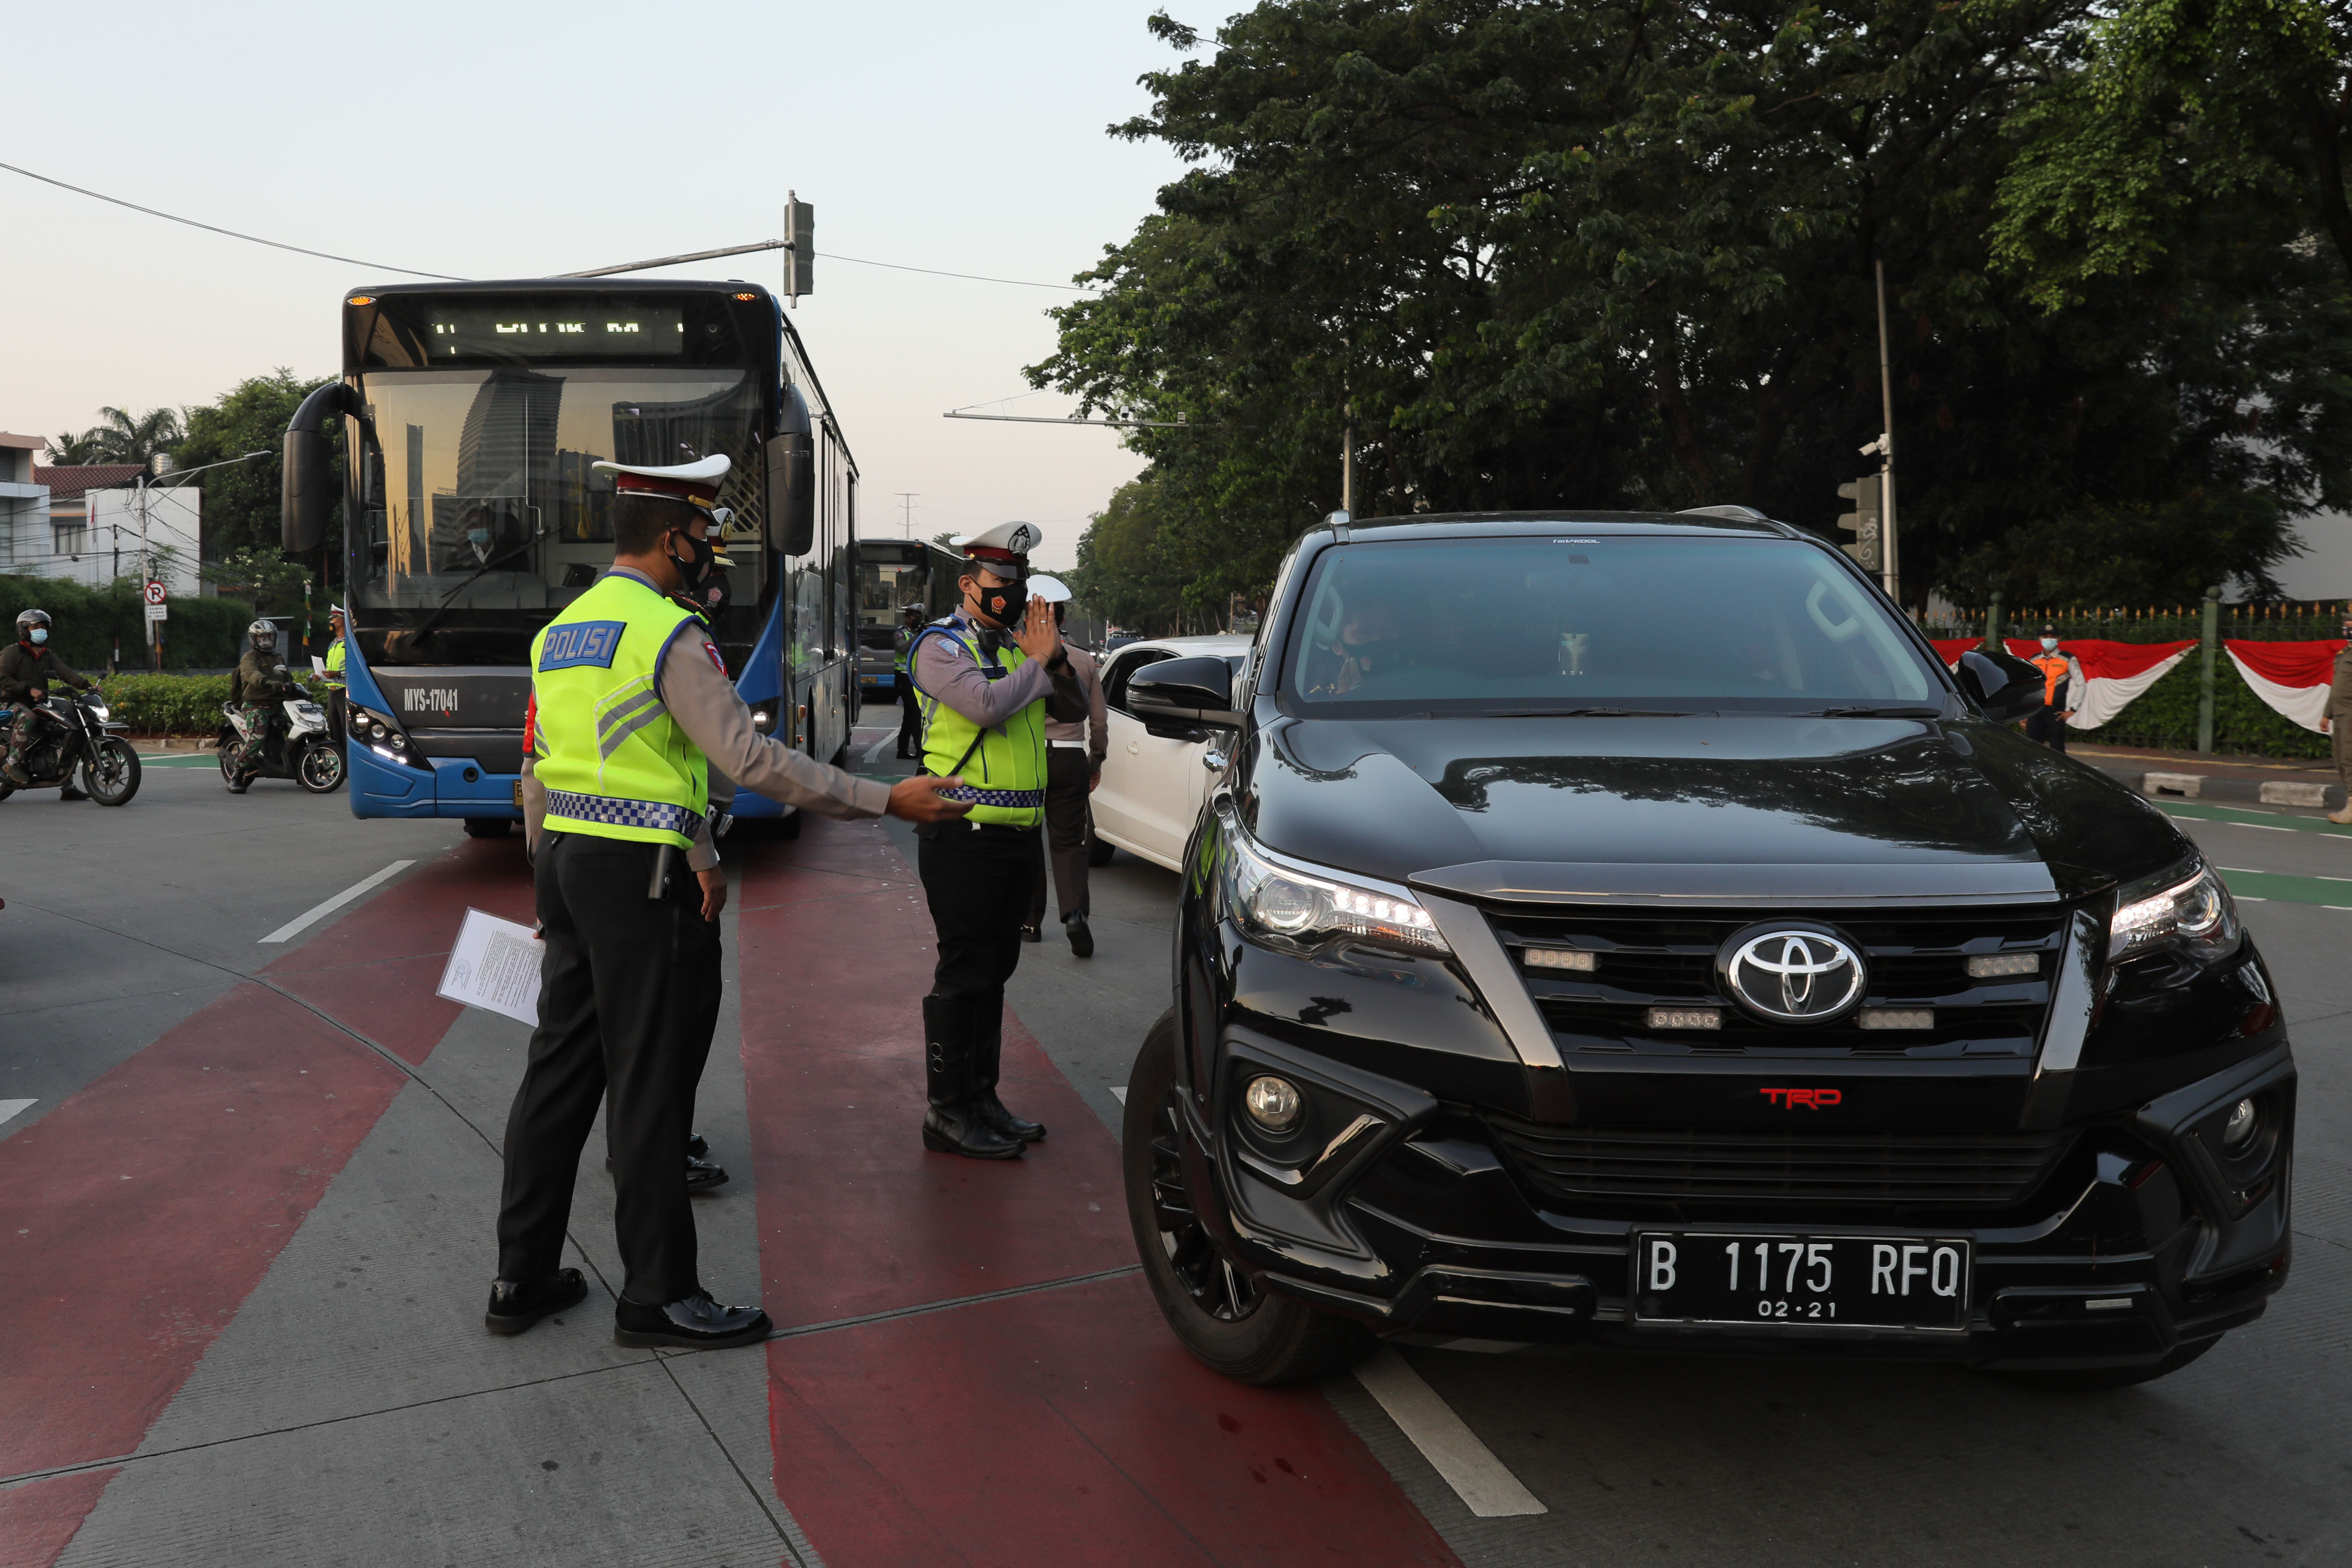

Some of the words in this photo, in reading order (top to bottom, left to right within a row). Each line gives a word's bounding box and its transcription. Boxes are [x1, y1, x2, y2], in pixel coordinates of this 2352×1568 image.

[541, 627, 617, 664] POLISI
[404, 688, 458, 711] MYS-17041
[1760, 1088, 1842, 1109] TRD
[1650, 1241, 1677, 1290] B
[1725, 1243, 1833, 1292] 1175
[1871, 1244, 1959, 1297] RFQ
